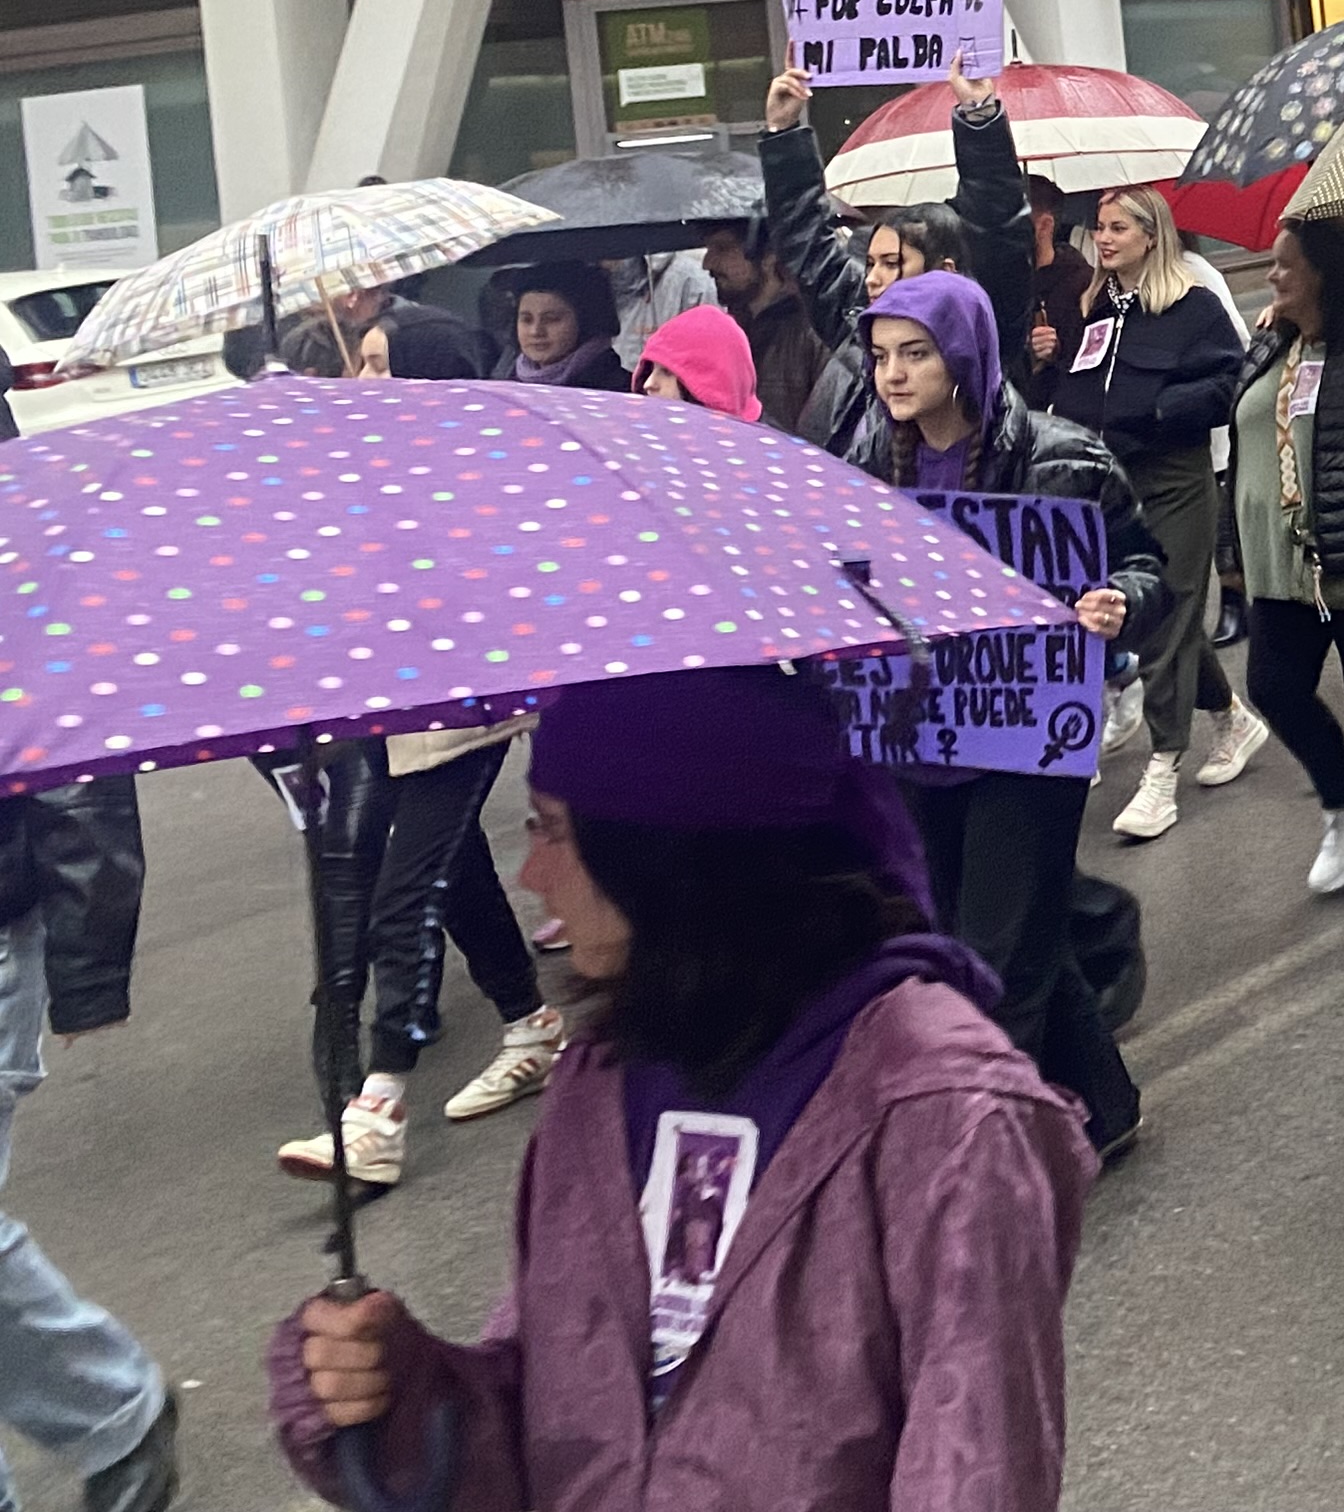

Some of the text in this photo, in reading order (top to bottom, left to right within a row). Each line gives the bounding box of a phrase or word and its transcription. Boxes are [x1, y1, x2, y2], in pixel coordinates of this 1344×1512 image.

[804, 39, 833, 74] MI
[1044, 632, 1086, 685] EN
[953, 687, 1038, 728] PUEDE
